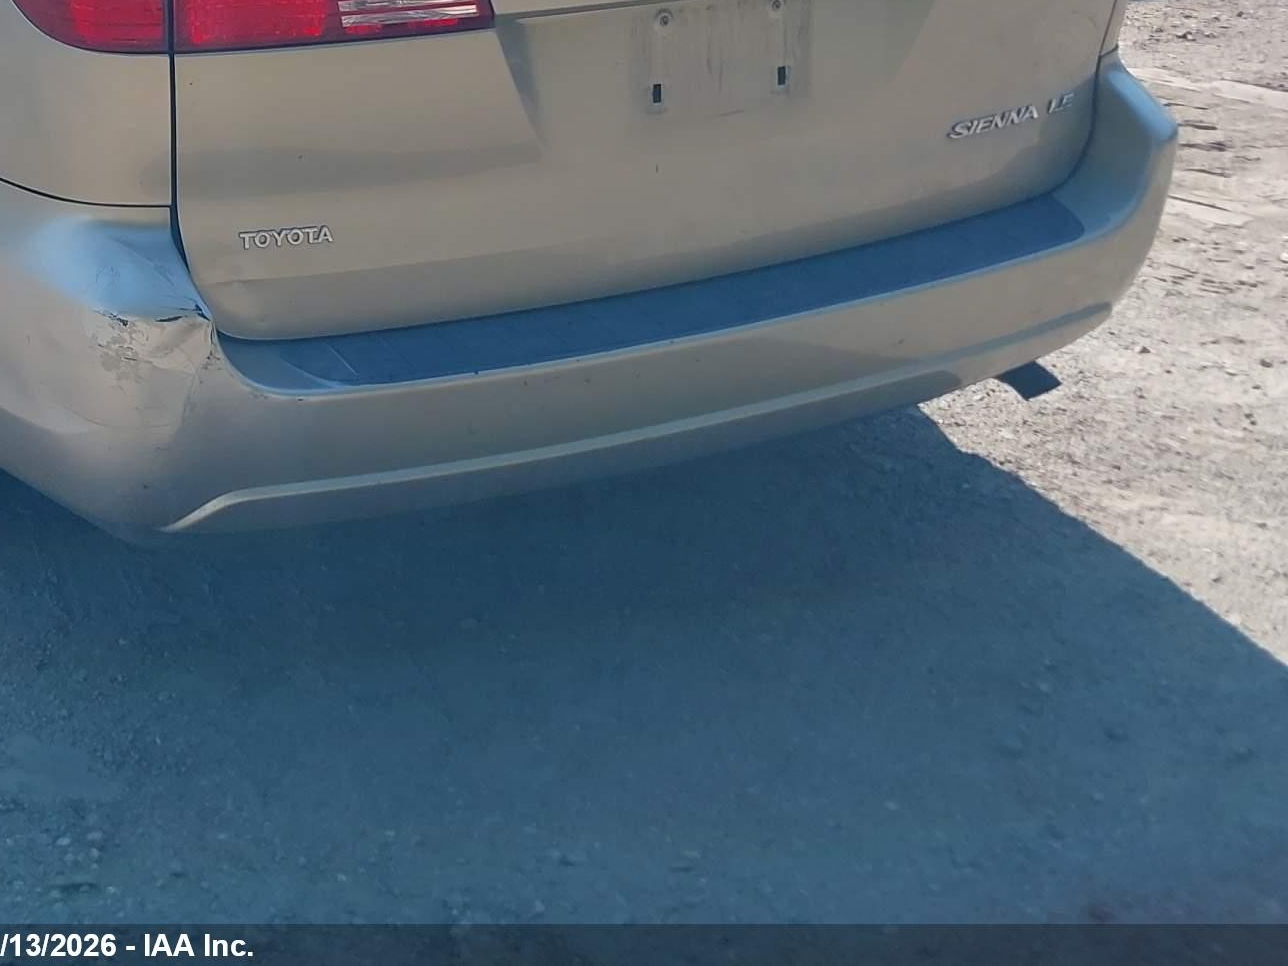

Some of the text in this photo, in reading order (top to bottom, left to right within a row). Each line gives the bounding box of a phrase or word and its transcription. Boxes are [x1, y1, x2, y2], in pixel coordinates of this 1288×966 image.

[948, 91, 1075, 139] SIENNA LE
[239, 225, 334, 250] TOYOTA
